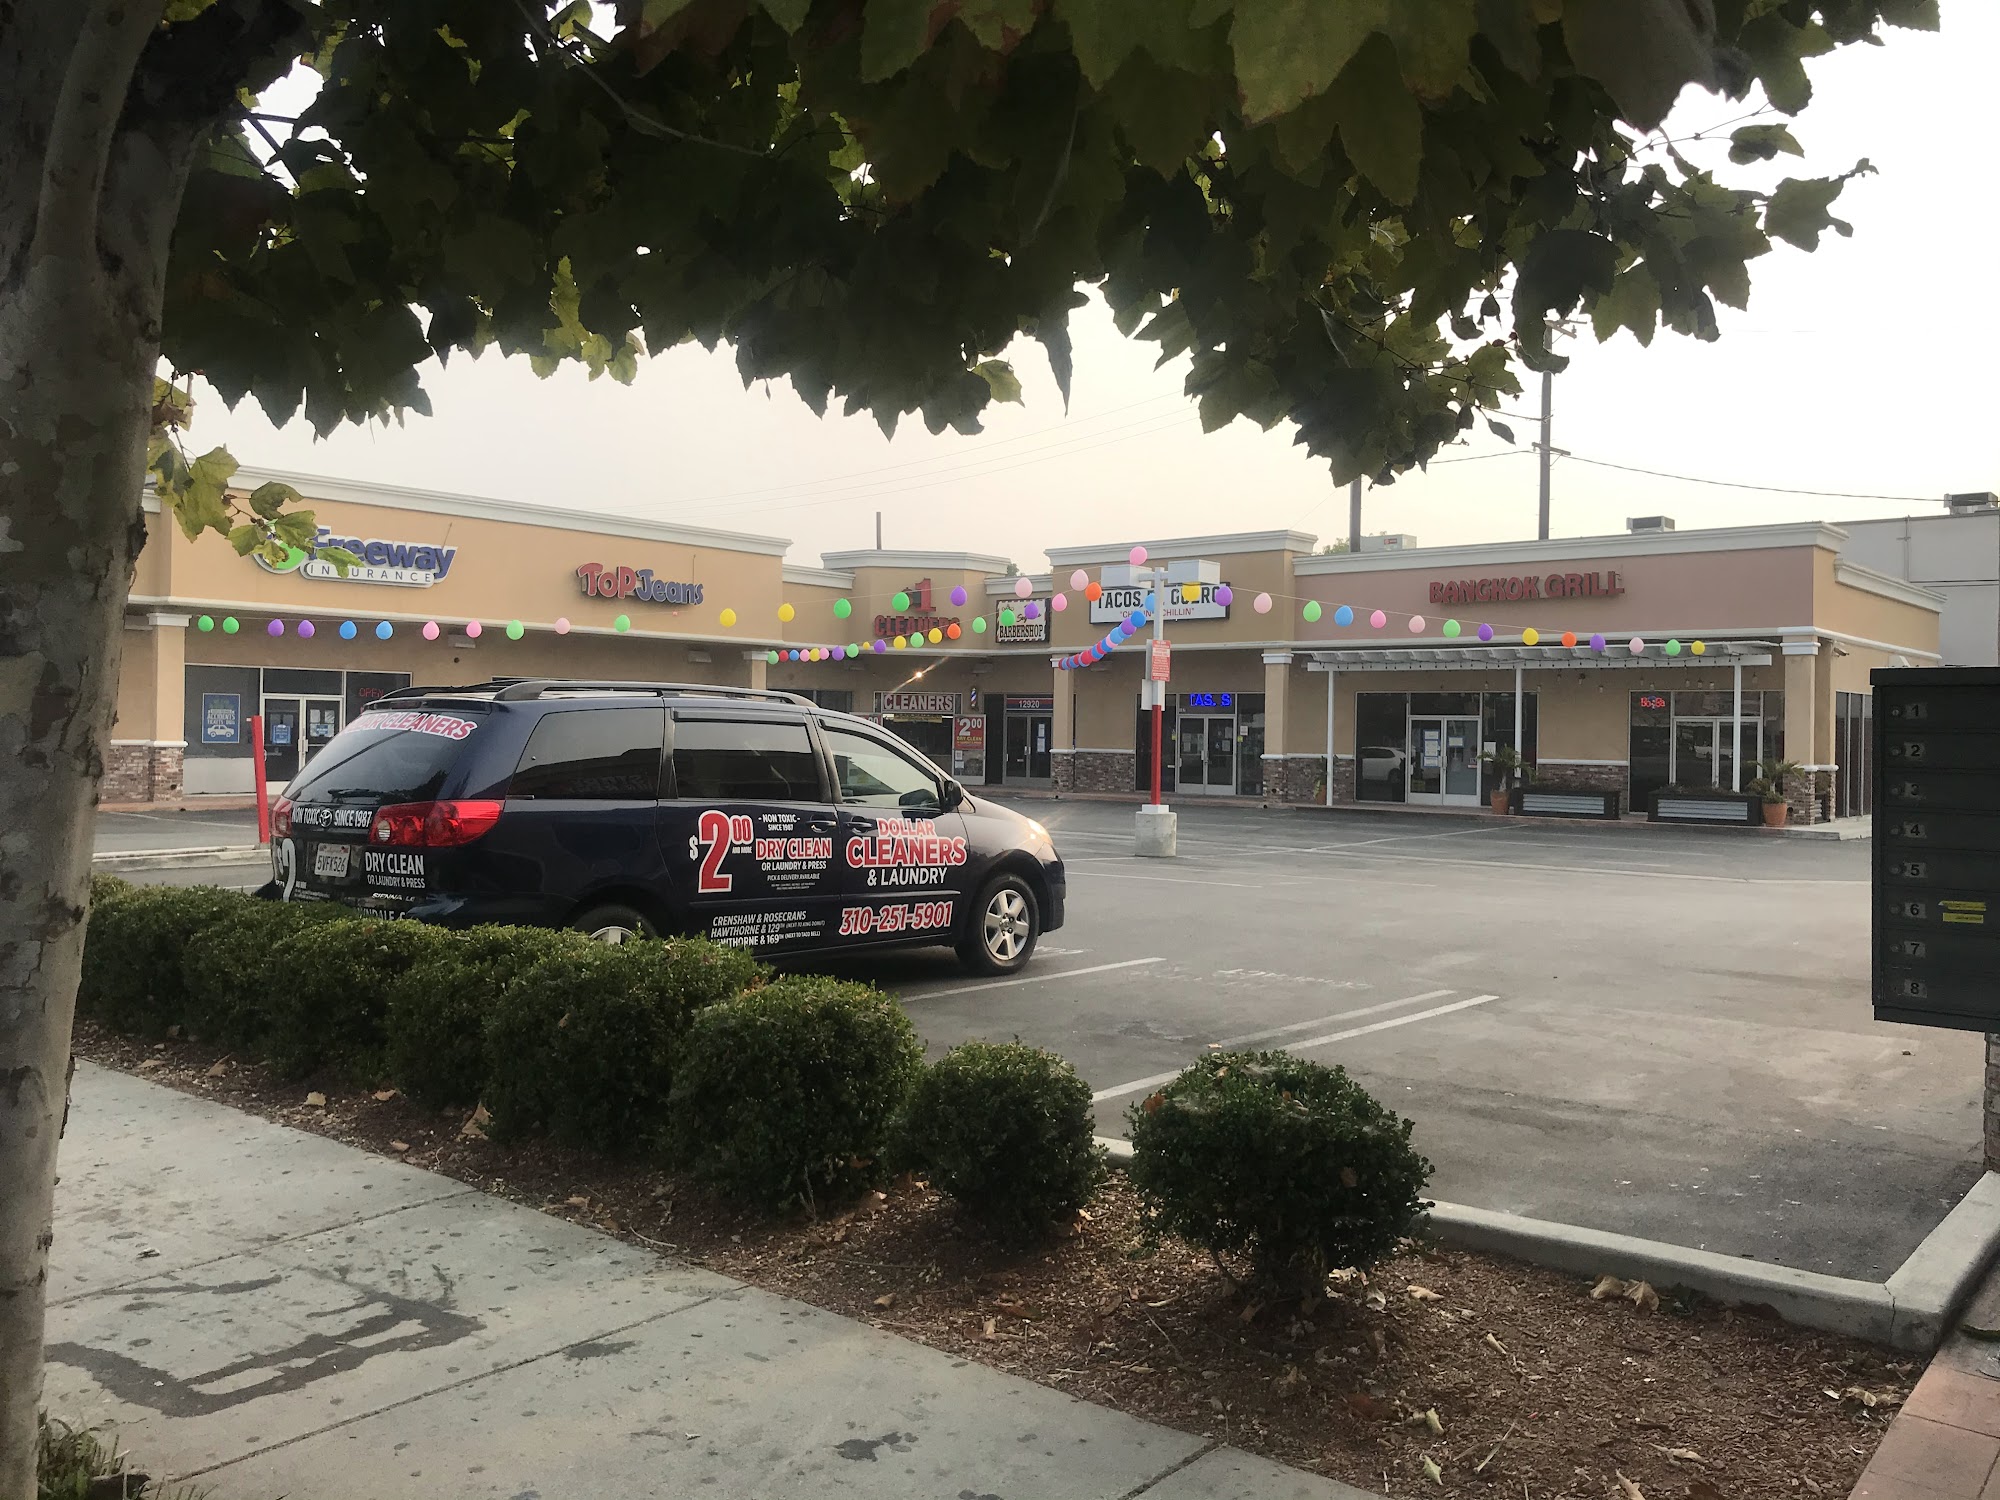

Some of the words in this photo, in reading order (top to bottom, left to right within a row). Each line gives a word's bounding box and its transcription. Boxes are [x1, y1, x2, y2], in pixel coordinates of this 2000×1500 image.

[312, 528, 456, 579] Freeway
[310, 564, 432, 583] INURANCE
[636, 569, 704, 605] Jeans
[1429, 576, 1540, 603] BANGKOK
[1544, 571, 1625, 598] GRILL
[1097, 591, 1141, 608] TACOS
[999, 624, 1044, 639] BARBERSHOP
[883, 694, 954, 712] CLEANERS
[1018, 700, 1040, 709] 12920
[1911, 704, 1919, 717] 1
[380, 712, 478, 740] CLEANERS
[1911, 744, 1920, 757] 2
[1911, 783, 1919, 796] 3
[334, 810, 354, 827] SINCE
[355, 811, 373, 828] 1987
[777, 814, 797, 823] TOXIC
[767, 824, 782, 832] SINCE
[782, 823, 794, 832] 1987
[876, 818, 937, 837] DOLLAR
[1910, 823, 1920, 836] 4
[756, 838, 786, 860] DRY
[786, 837, 833, 859] CLEAN
[846, 836, 967, 868] CLEANERS
[365, 851, 386, 874] DRY
[387, 852, 425, 876] CLEAN
[761, 862, 771, 871] OR
[772, 862, 801, 871] LAUNDRY
[801, 862, 807, 870] &
[808, 860, 827, 870] PRESS
[1910, 864, 1920, 876] 5
[367, 874, 376, 885] OR
[376, 876, 400, 888] LAUNDRY
[401, 877, 406, 887] &
[406, 878, 425, 889] PRESS
[867, 868, 877, 886] &
[880, 867, 947, 886] LAUNDRY
[372, 892, 402, 901] SIENNA
[1910, 903, 1919, 917] 6
[712, 914, 757, 927] CRENSHAW
[756, 913, 763, 923] &
[763, 910, 807, 923] ROSECRANS
[839, 901, 954, 936] 310-251-5901
[710, 925, 761, 938] HAWTHORNE
[760, 924, 767, 934] &
[711, 935, 759, 950] WTHORNE
[759, 934, 766, 945] &
[1910, 942, 1920, 955] 7
[1910, 982, 1919, 994] 8
